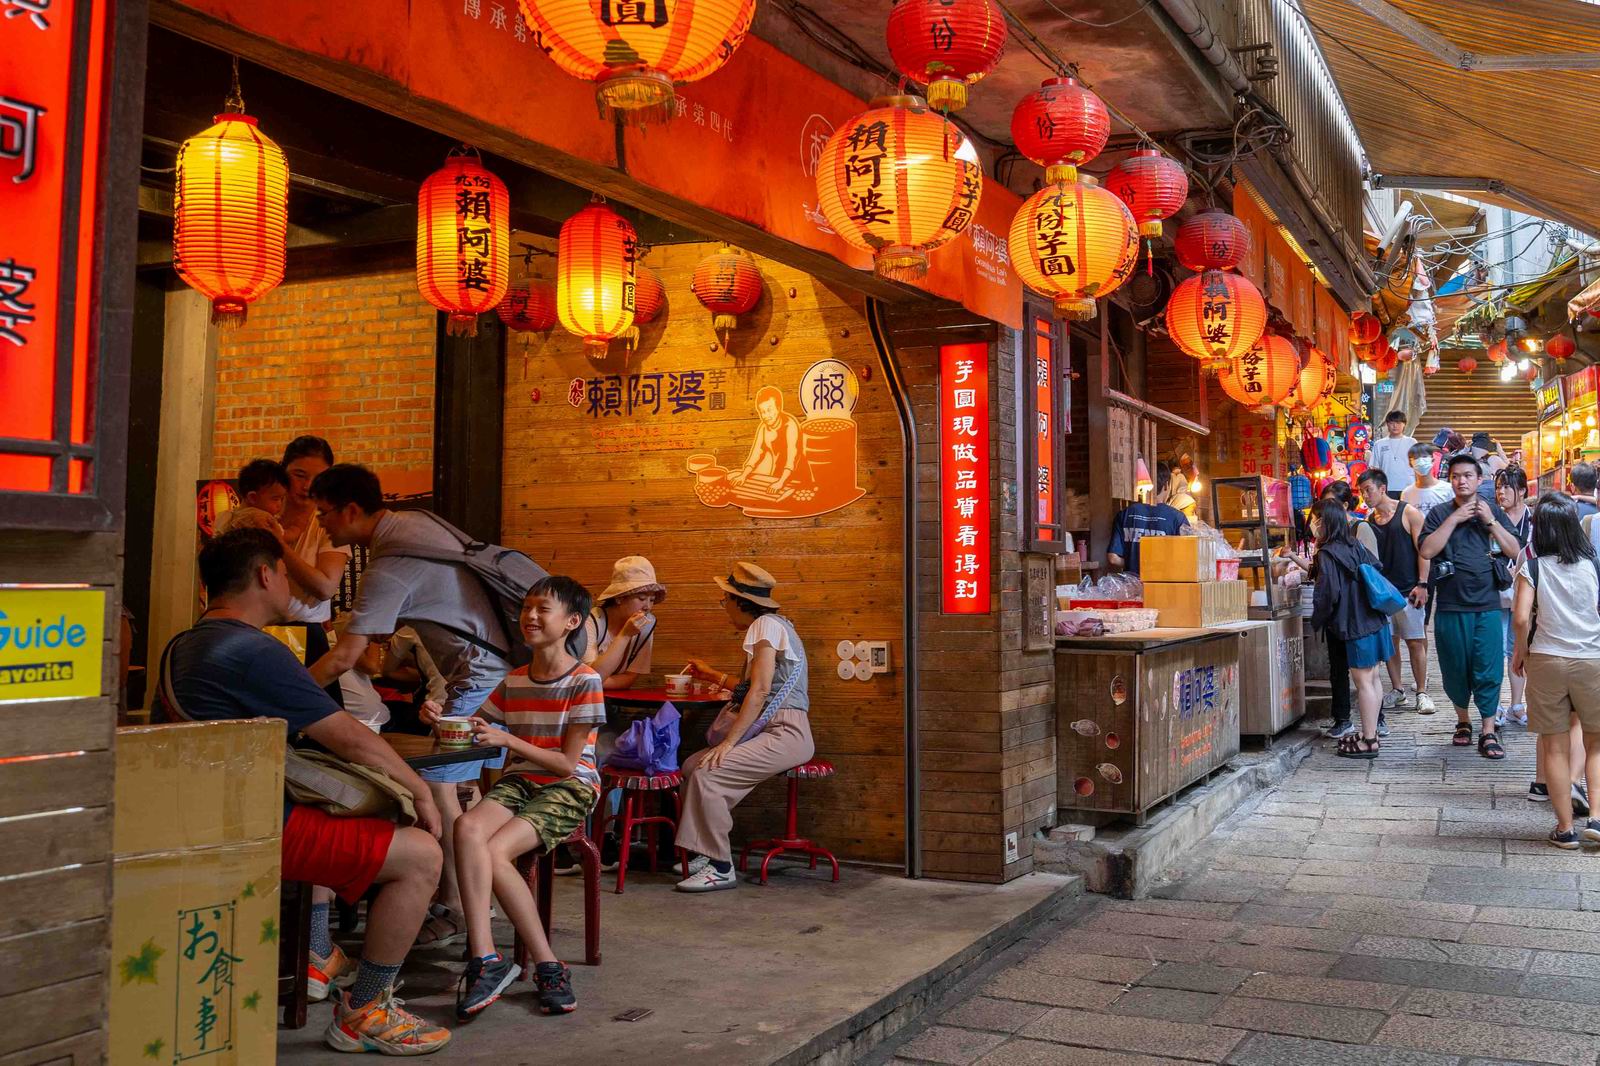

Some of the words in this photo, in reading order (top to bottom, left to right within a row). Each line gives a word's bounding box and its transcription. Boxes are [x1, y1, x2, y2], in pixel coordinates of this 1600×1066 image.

[844, 121, 894, 224] 賴阿婆
[456, 190, 492, 292] 賴阿婆
[1034, 193, 1076, 277] 九份芋圓
[586, 370, 706, 417] 賴阿婆
[708, 369, 726, 411] 芋圓
[952, 359, 980, 599] 芋圓現做品質看得到
[182, 910, 244, 1050] お食事
